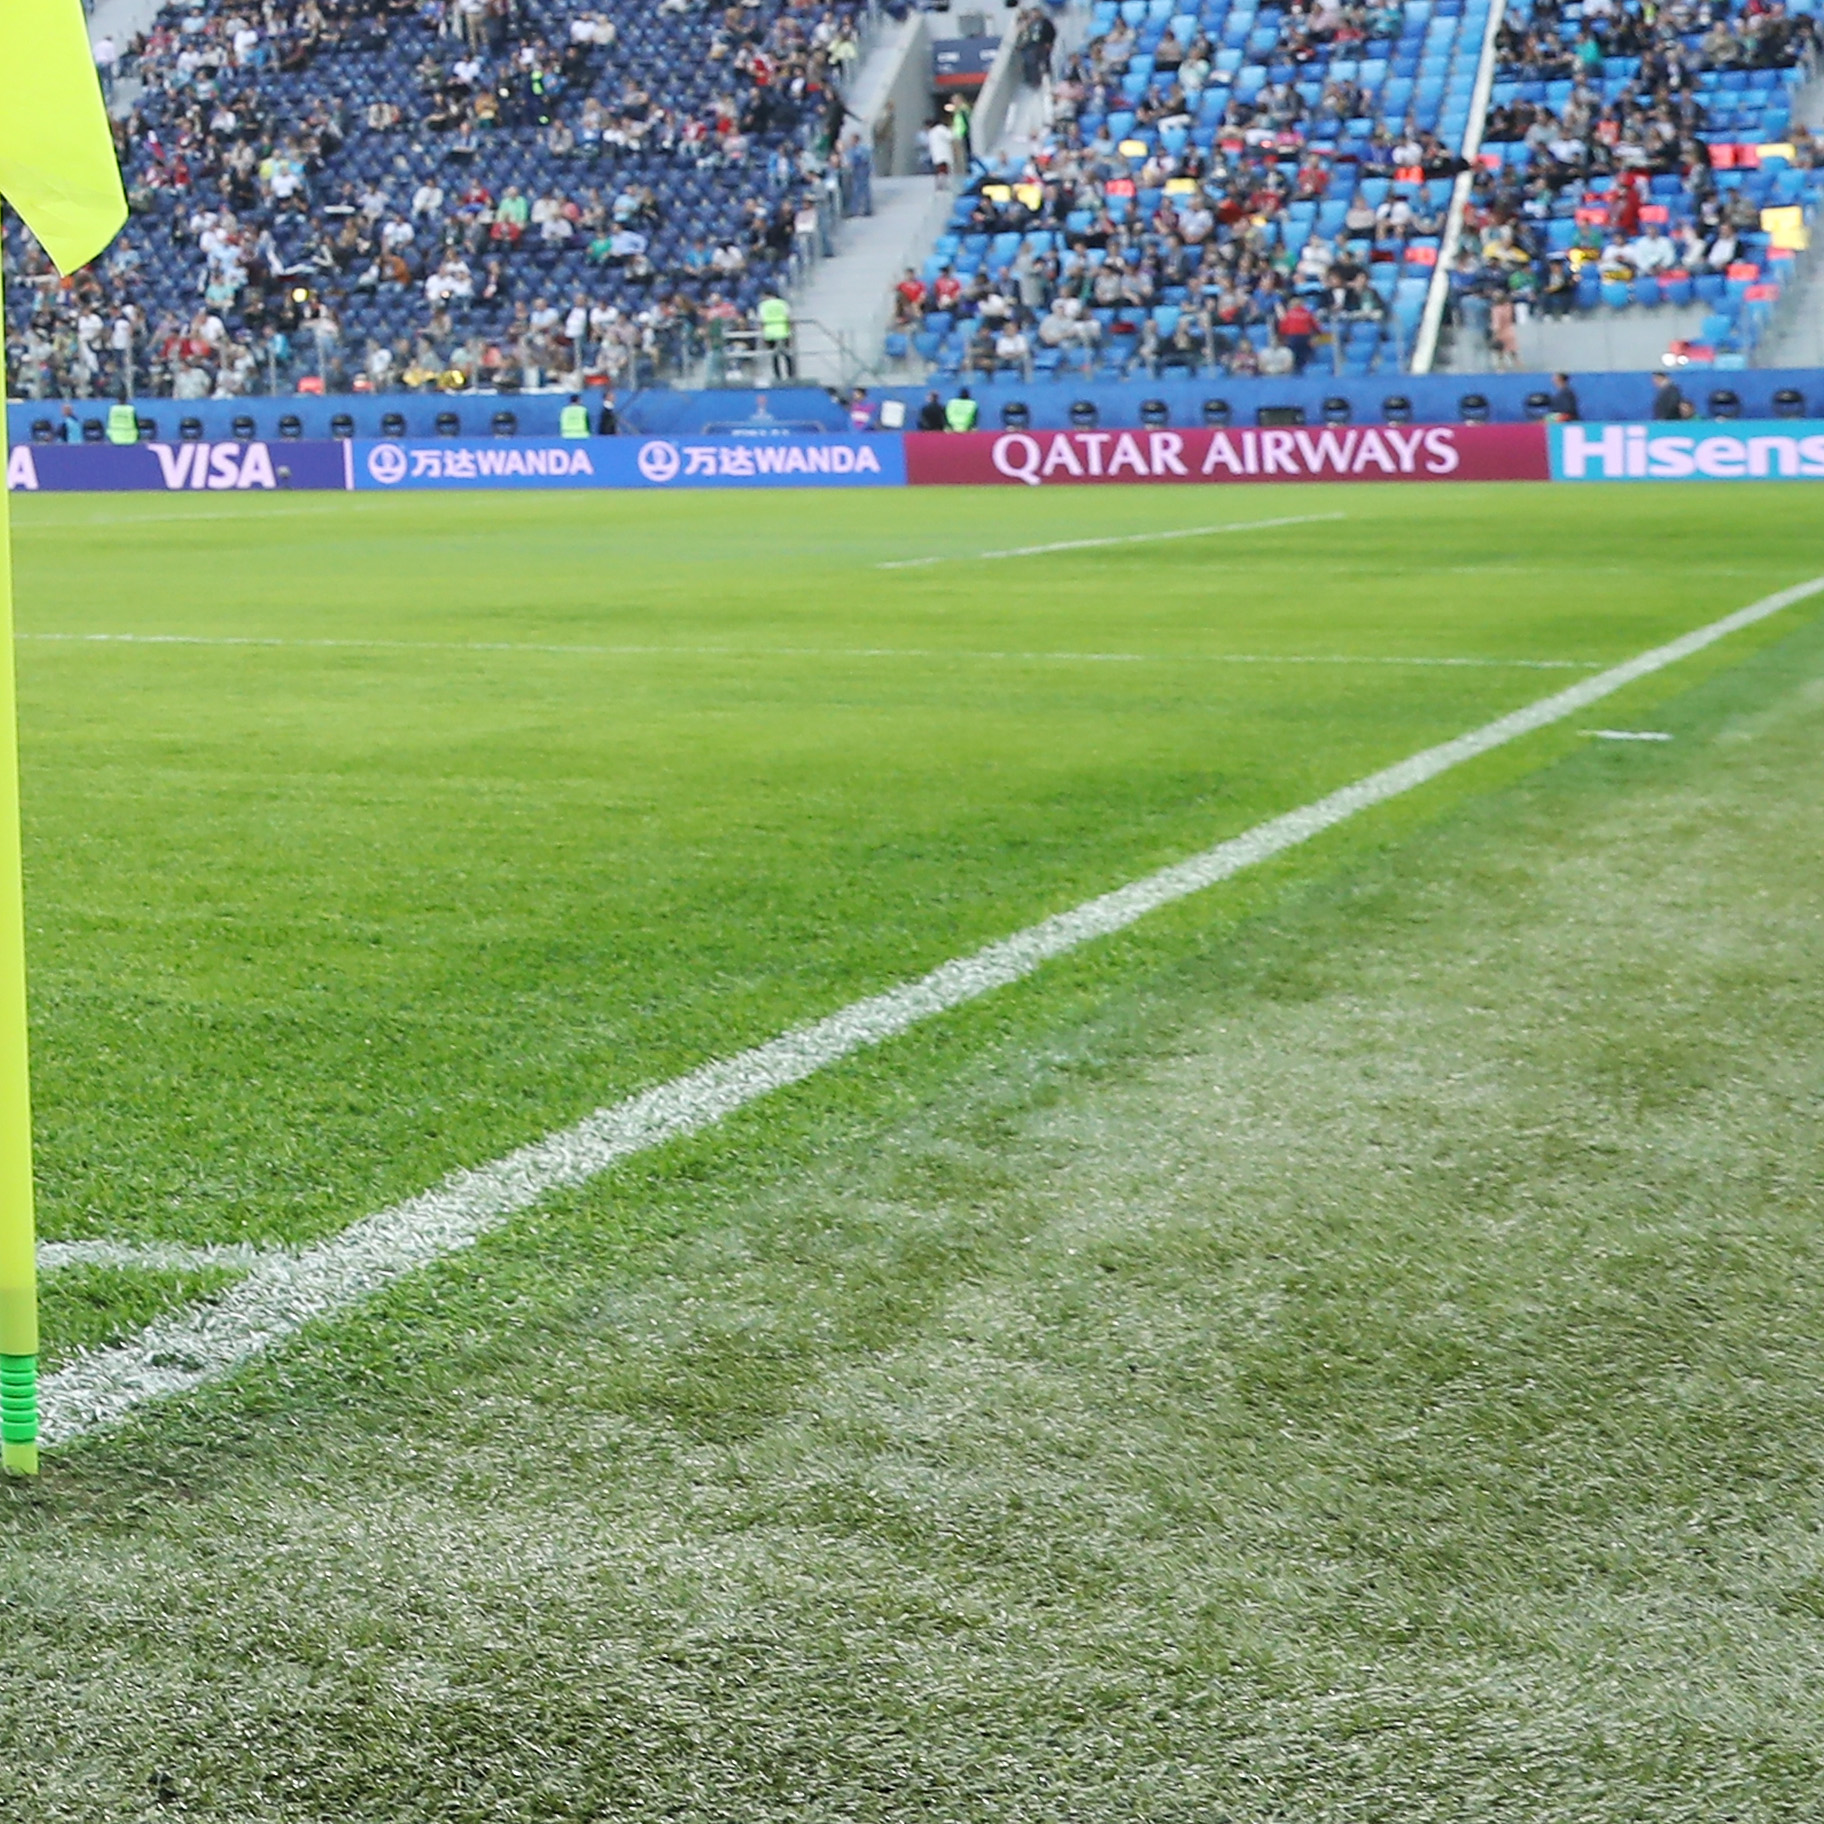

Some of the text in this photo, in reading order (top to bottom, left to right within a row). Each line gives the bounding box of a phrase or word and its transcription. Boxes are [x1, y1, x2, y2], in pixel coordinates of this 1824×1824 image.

[148, 442, 277, 490] VISA
[992, 427, 1459, 485] QATAR AIRWAYS
